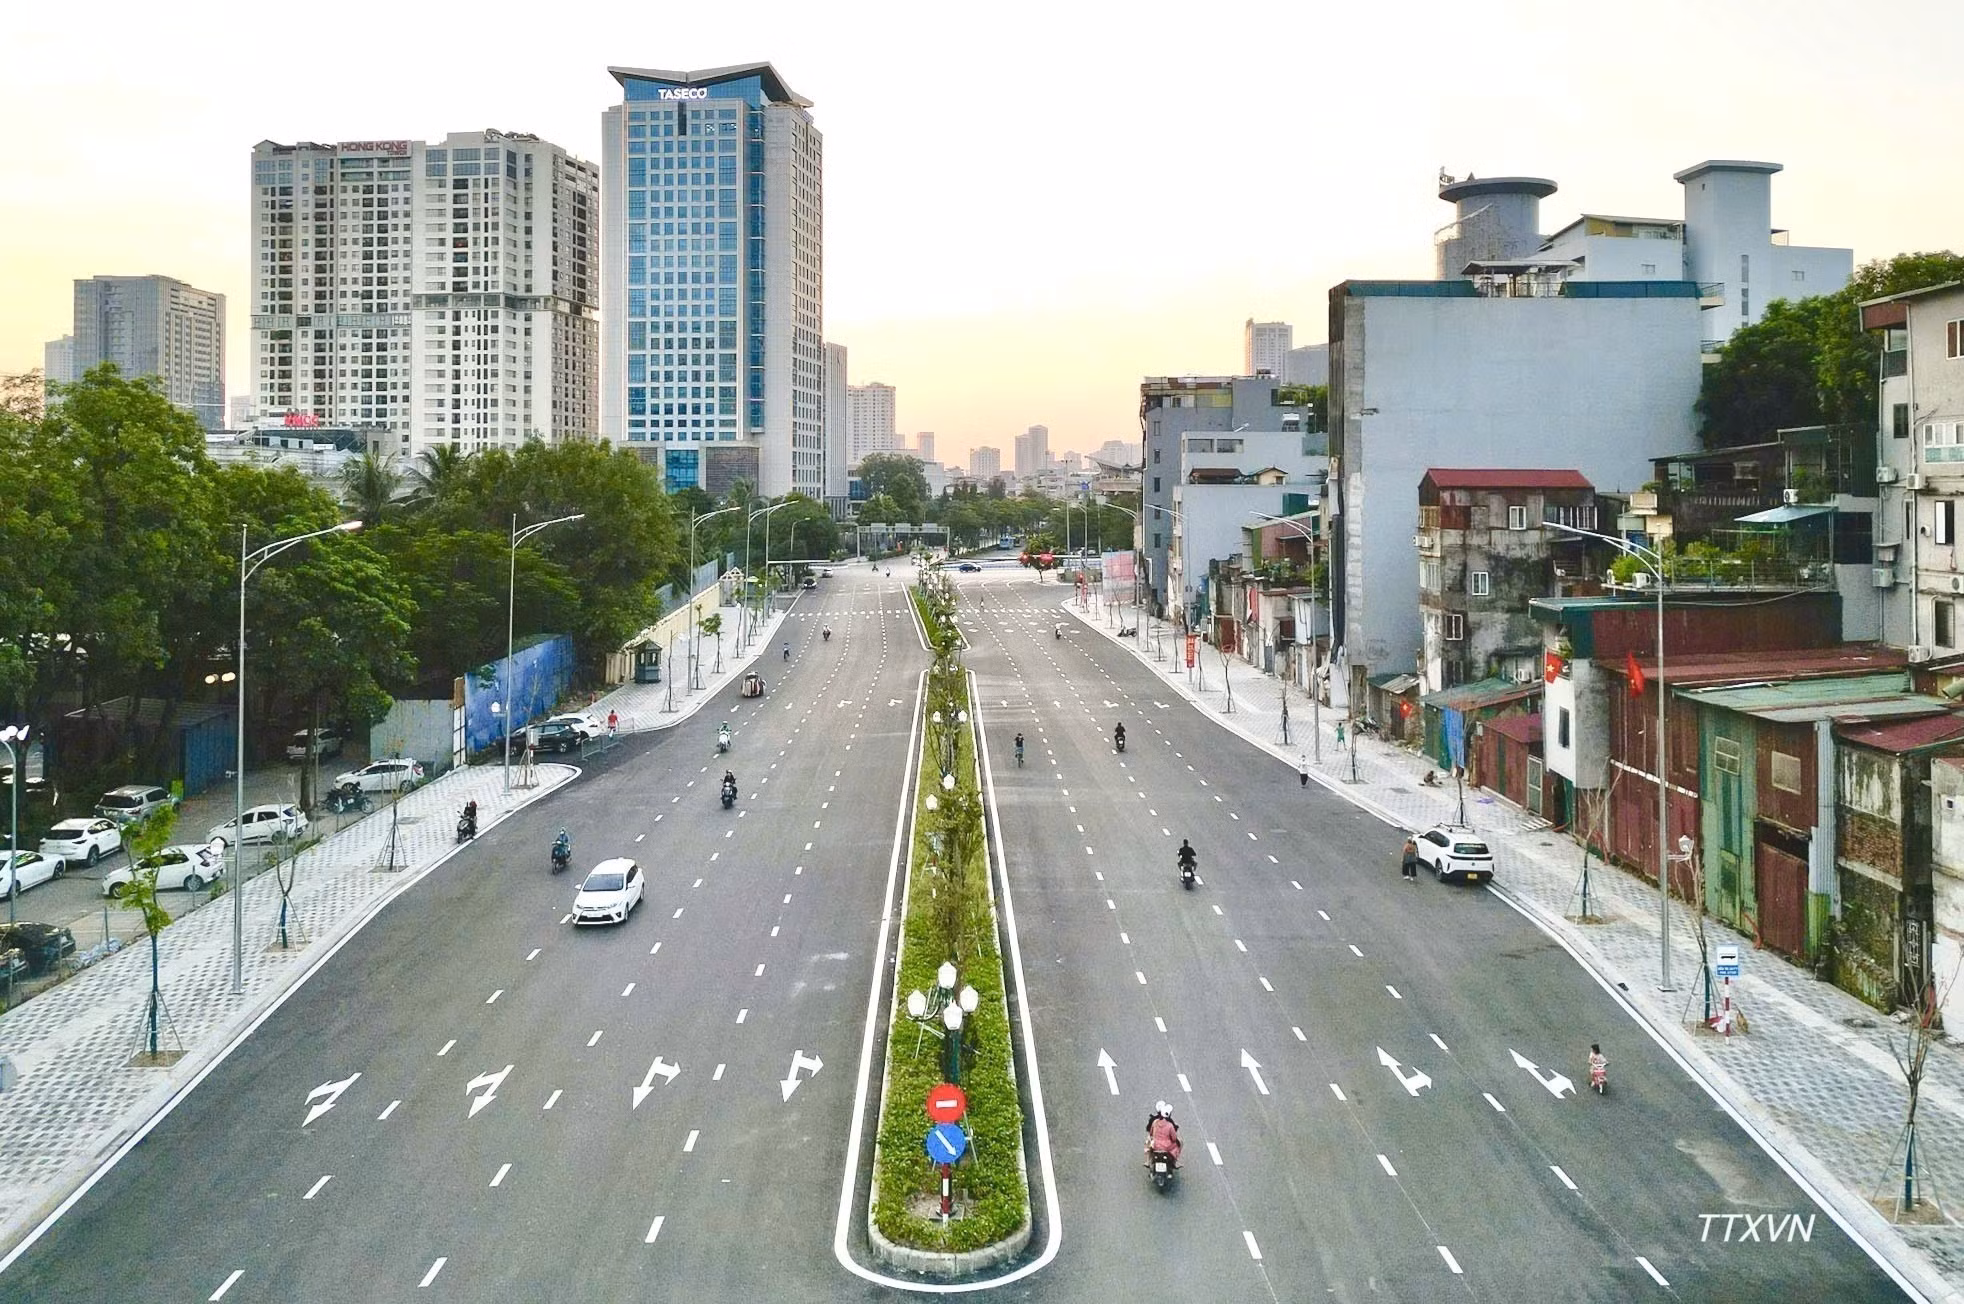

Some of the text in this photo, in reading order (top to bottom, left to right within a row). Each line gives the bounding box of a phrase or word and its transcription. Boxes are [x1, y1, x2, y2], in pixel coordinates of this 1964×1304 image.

[657, 87, 707, 100] TASECO
[341, 140, 408, 152] HONG KONG
